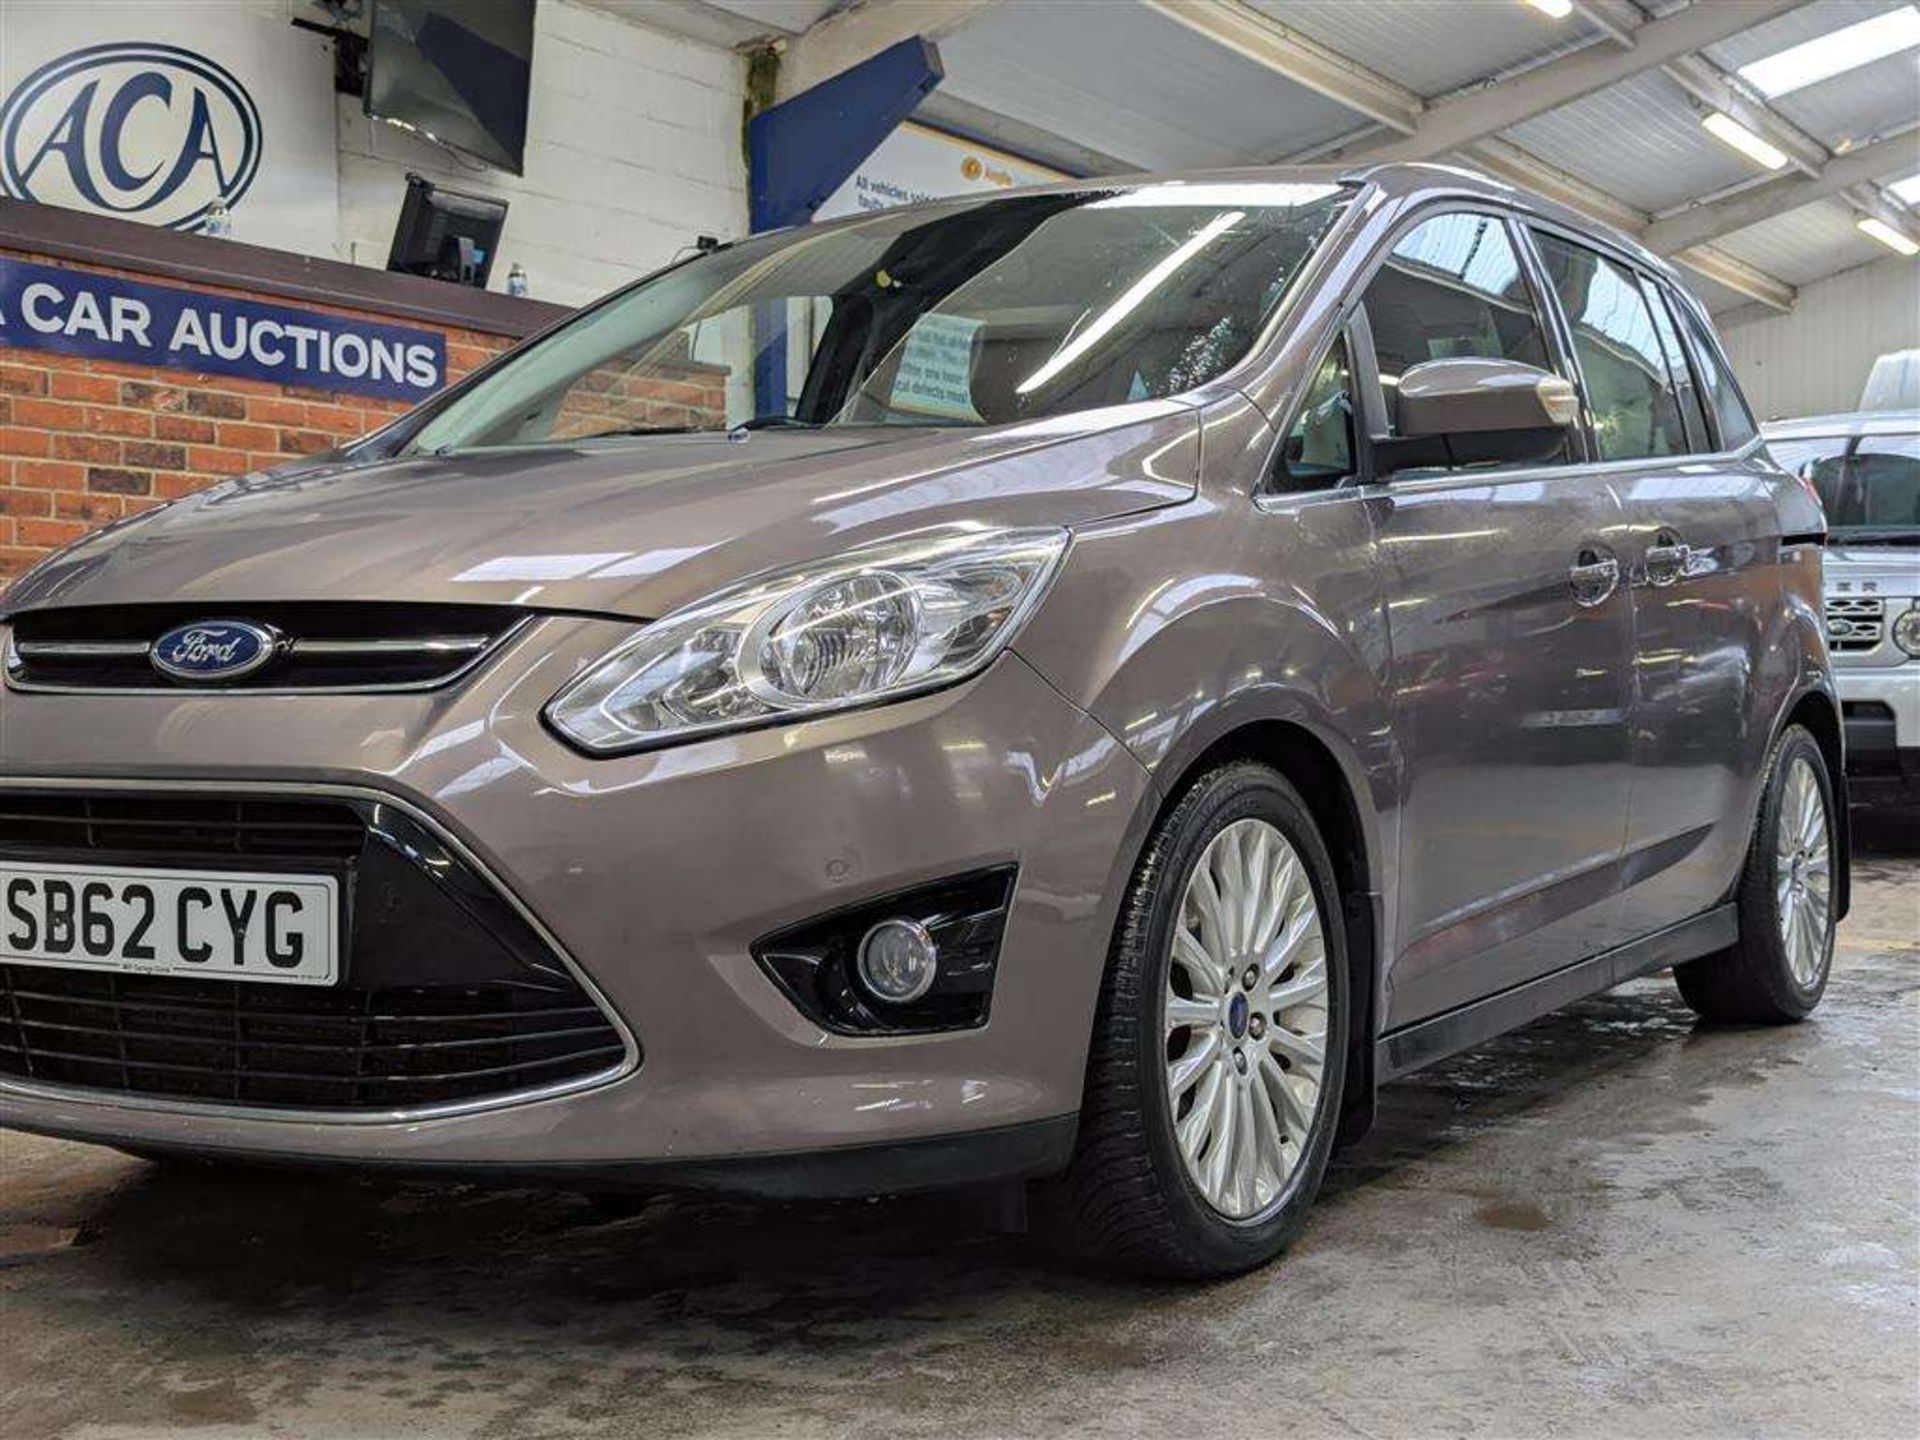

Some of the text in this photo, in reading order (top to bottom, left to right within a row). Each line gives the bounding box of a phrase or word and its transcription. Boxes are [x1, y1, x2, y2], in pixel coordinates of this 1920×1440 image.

[19, 71, 232, 211] ACA
[21, 283, 438, 388] CAR AUCTIONS
[172, 629, 241, 662] Ford
[8, 878, 304, 968] SB62 CYG
